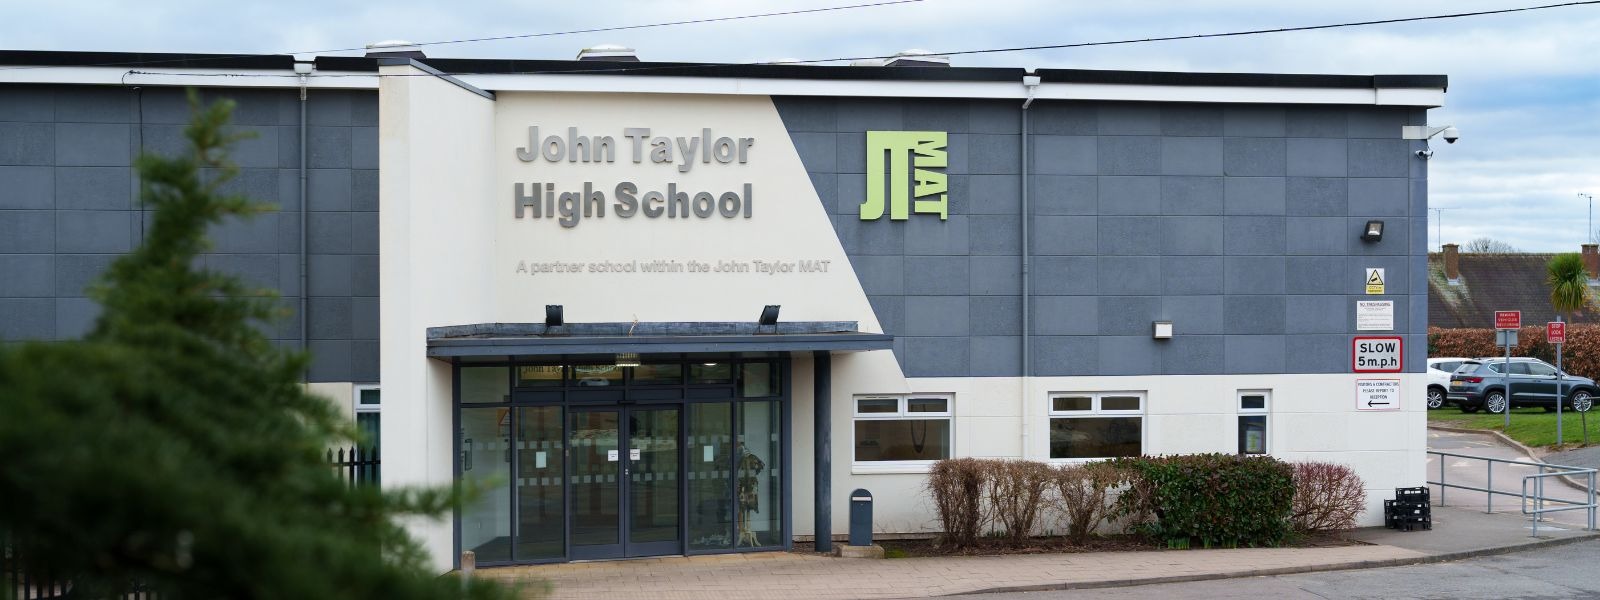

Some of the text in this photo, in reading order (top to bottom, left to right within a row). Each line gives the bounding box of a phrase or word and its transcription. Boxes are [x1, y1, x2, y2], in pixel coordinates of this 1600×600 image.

[516, 126, 755, 173] John Taylor
[913, 131, 948, 220] MAT
[514, 181, 753, 229] High School
[516, 259, 831, 275] A partner school within the John Taylor MAT
[1360, 342, 1396, 353] SLOW
